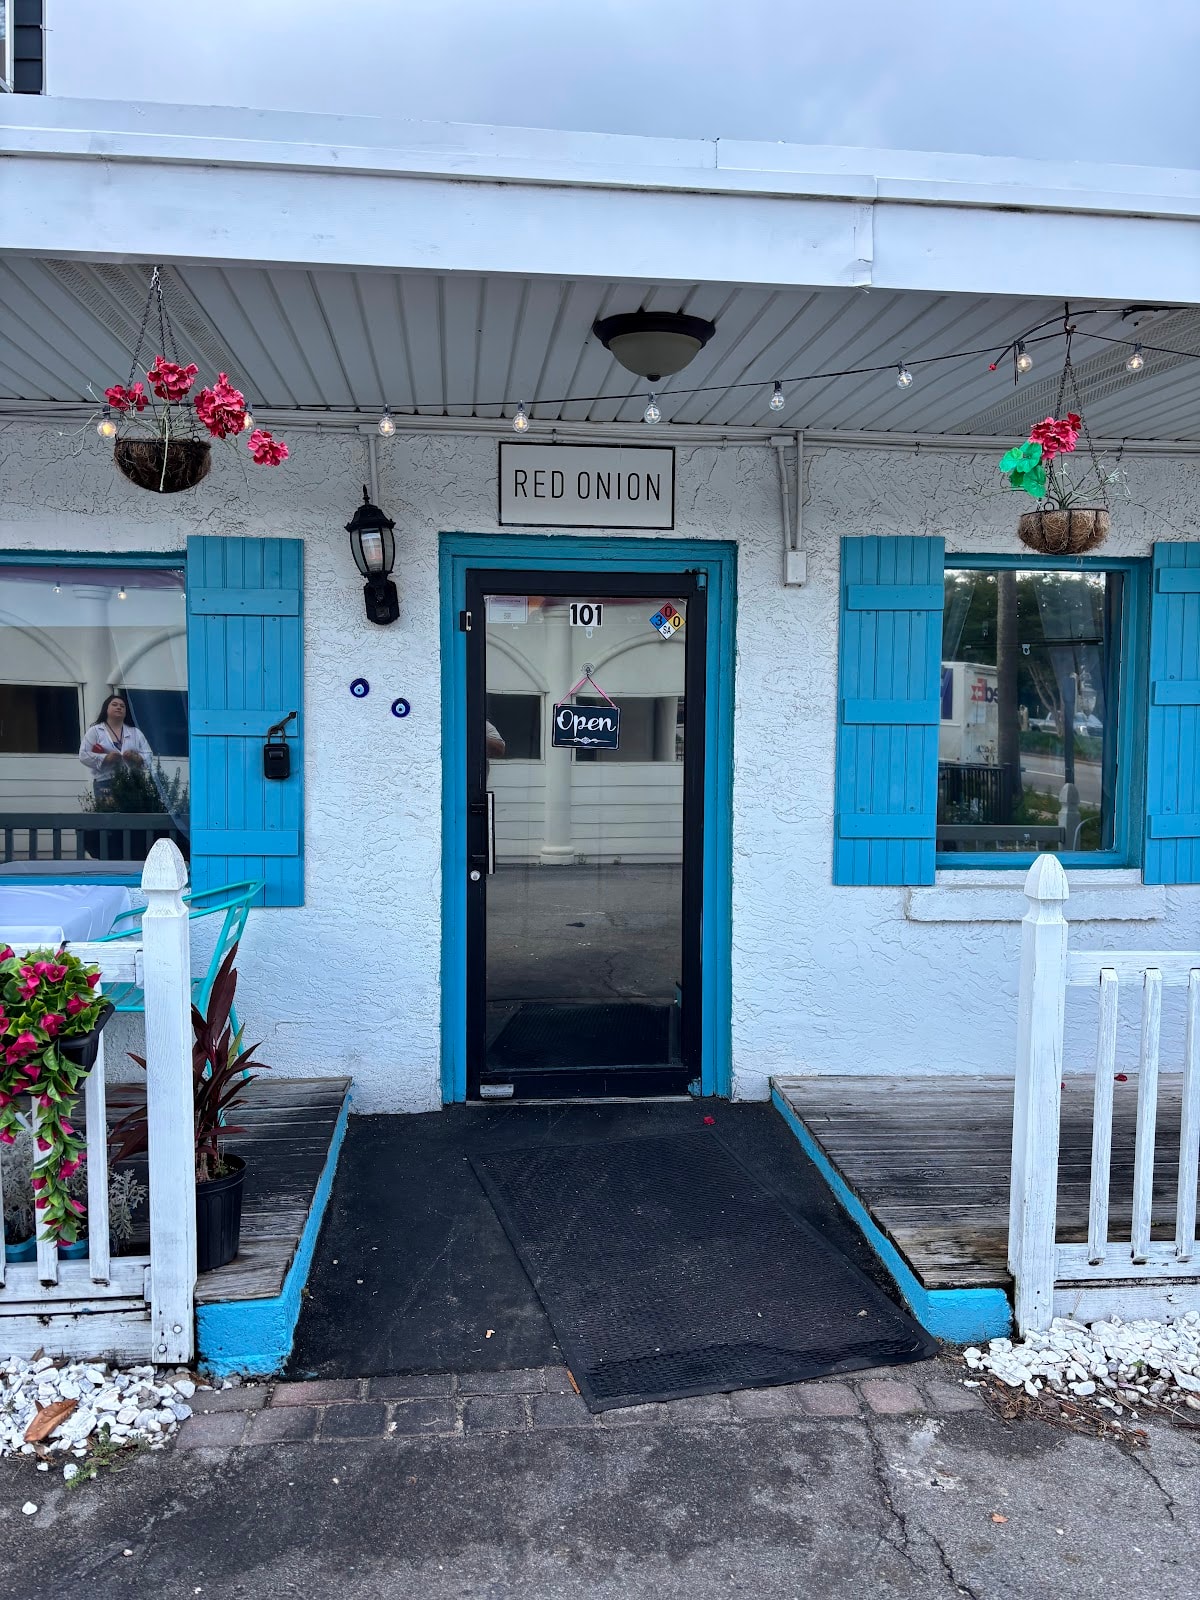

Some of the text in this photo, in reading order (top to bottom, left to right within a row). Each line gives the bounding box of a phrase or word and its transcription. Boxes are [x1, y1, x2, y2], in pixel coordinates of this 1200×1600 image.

[514, 469, 661, 501] RED ONION
[570, 603, 602, 626] 101
[654, 614, 663, 627] 3
[664, 605, 673, 618] 0
[672, 615, 681, 628] 0
[556, 709, 617, 737] Open
